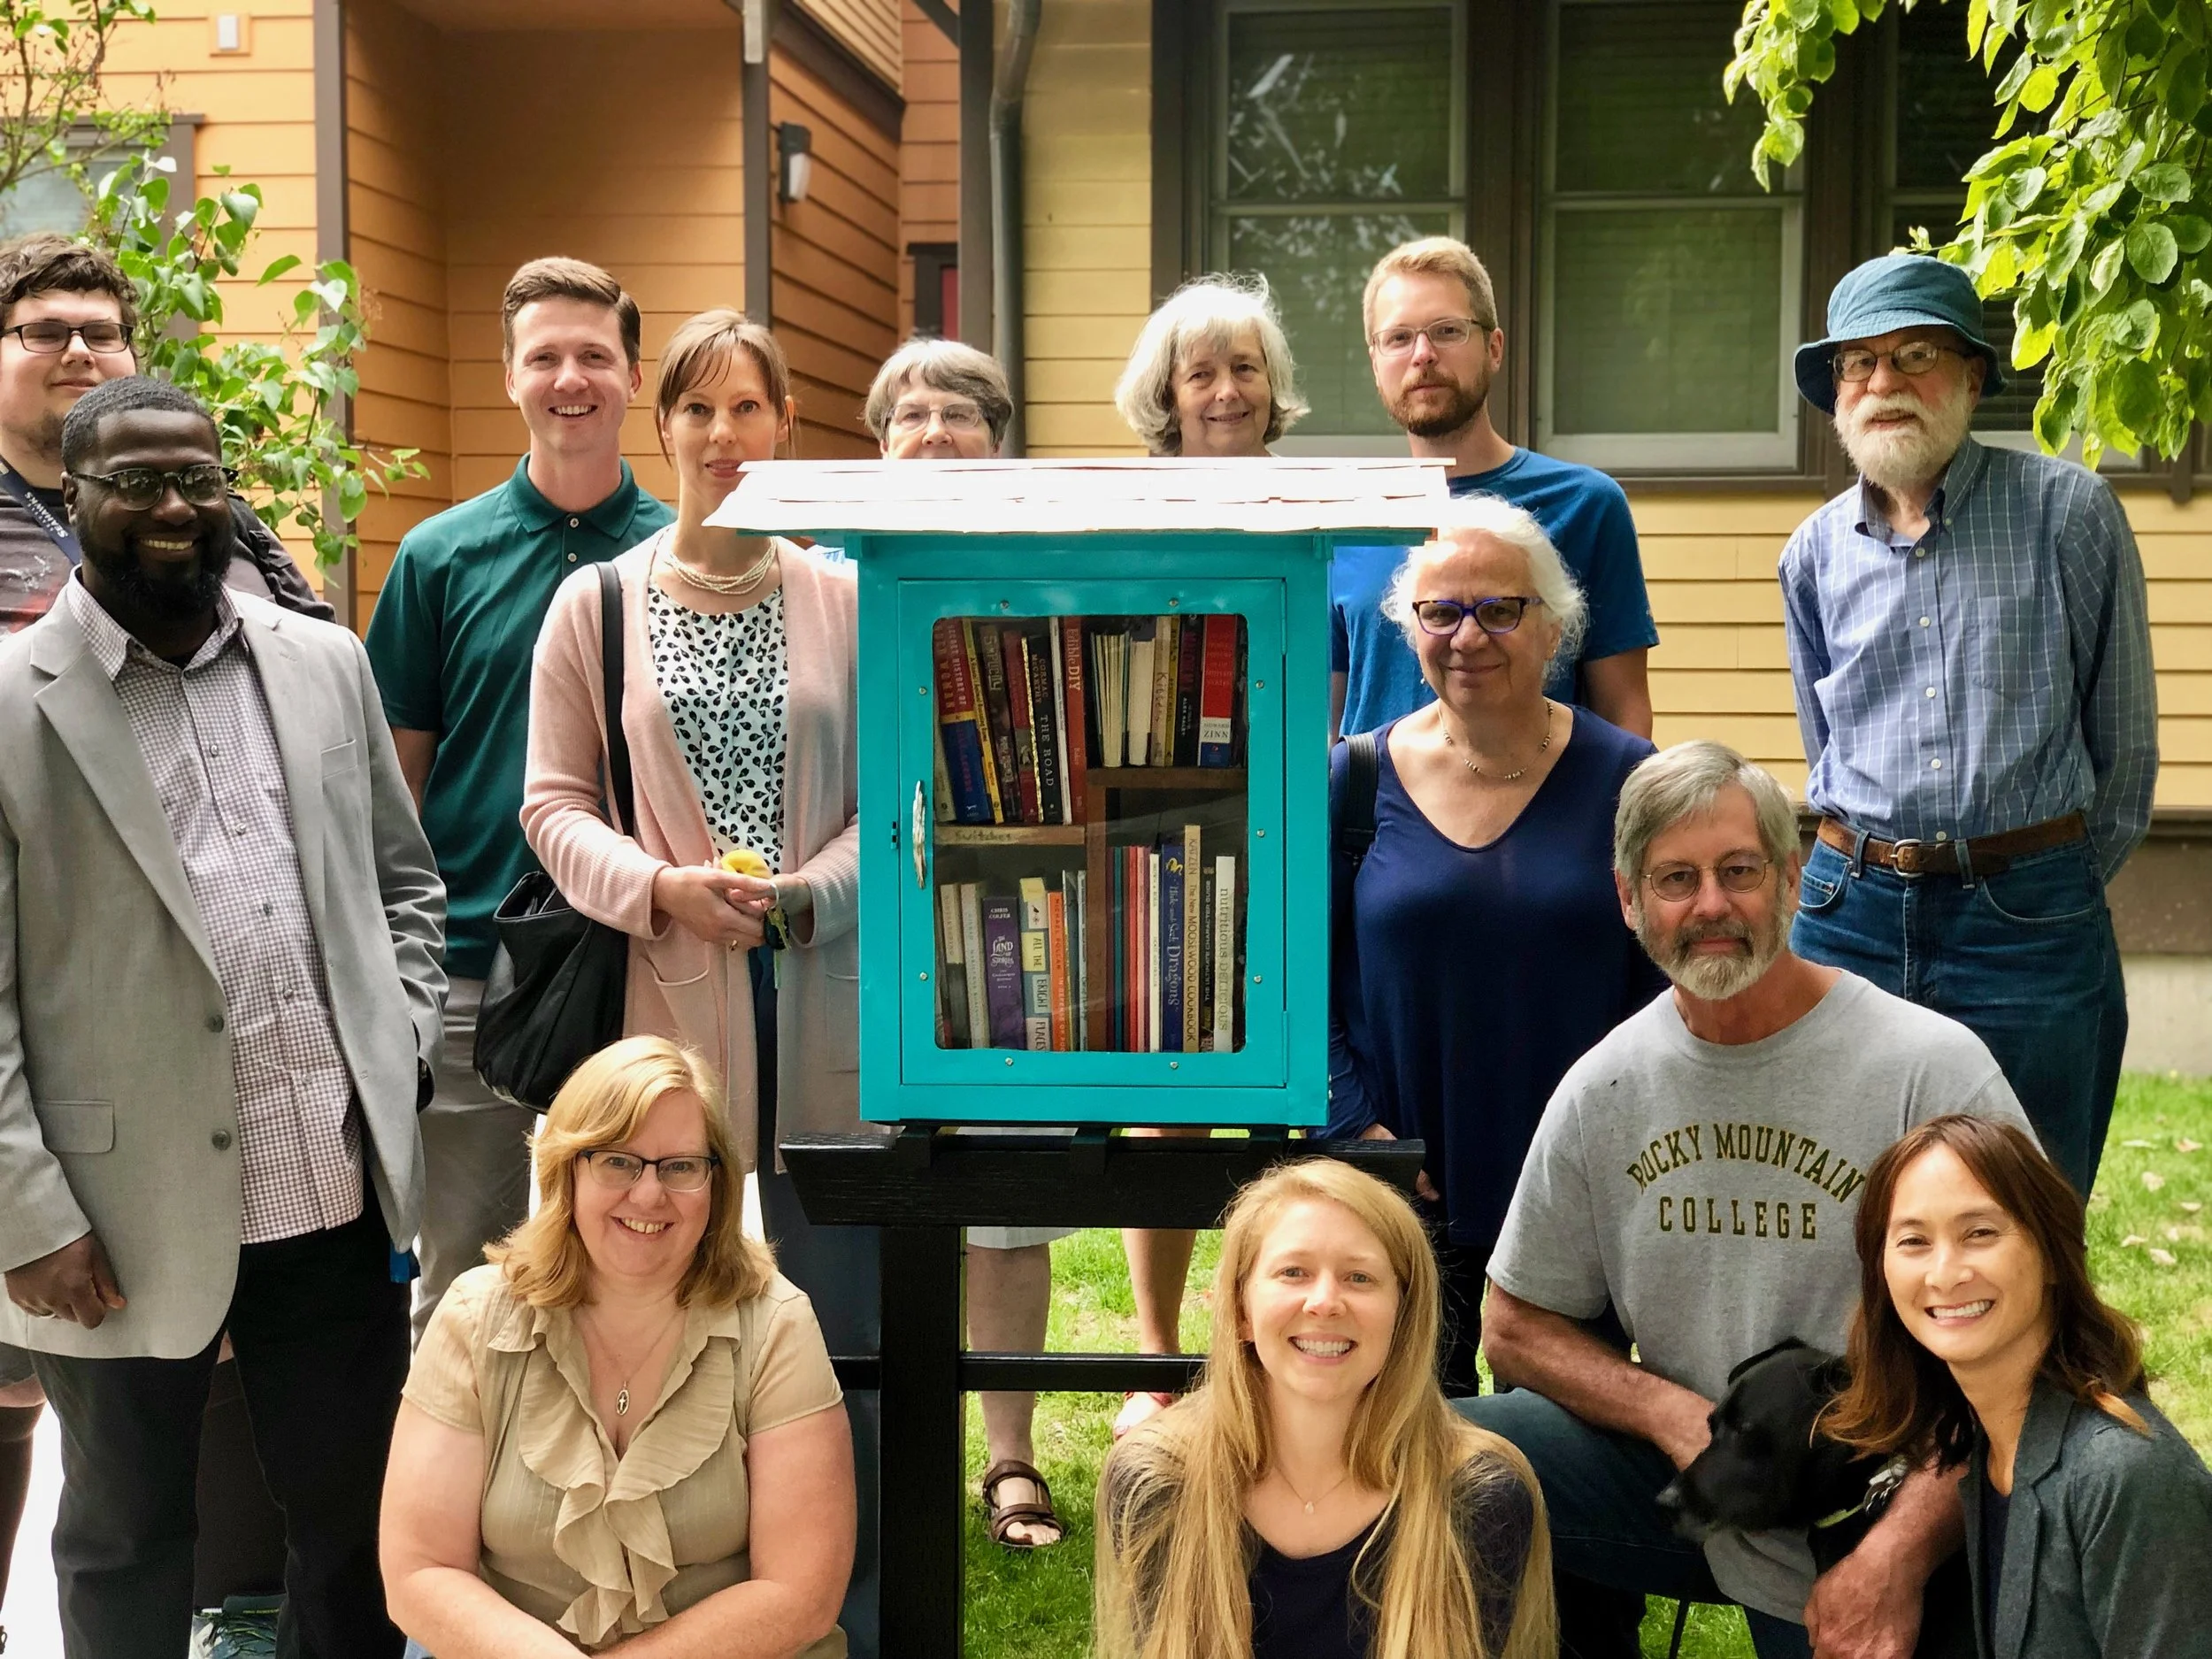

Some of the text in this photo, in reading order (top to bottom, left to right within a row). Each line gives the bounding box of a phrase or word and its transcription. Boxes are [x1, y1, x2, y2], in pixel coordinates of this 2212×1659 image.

[25, 492, 68, 537] SEAHAWKS
[953, 657, 965, 692] HISTORY
[1041, 715, 1055, 787] THE ROAD
[1189, 839, 1199, 875] KATZEN
[991, 940, 1014, 956] LAND
[1033, 938, 1042, 967] ALL THE
[1187, 916, 1198, 982] MOOSEWOOD
[1219, 888, 1229, 1031] nutritious DELICIOUS
[1037, 979, 1048, 1008] BRIGHT
[1165, 945, 1182, 1006] Dragons
[1626, 1123, 1866, 1203] ROCKY MOUNTAIN
[1659, 1196, 1816, 1240] COLLEGE
